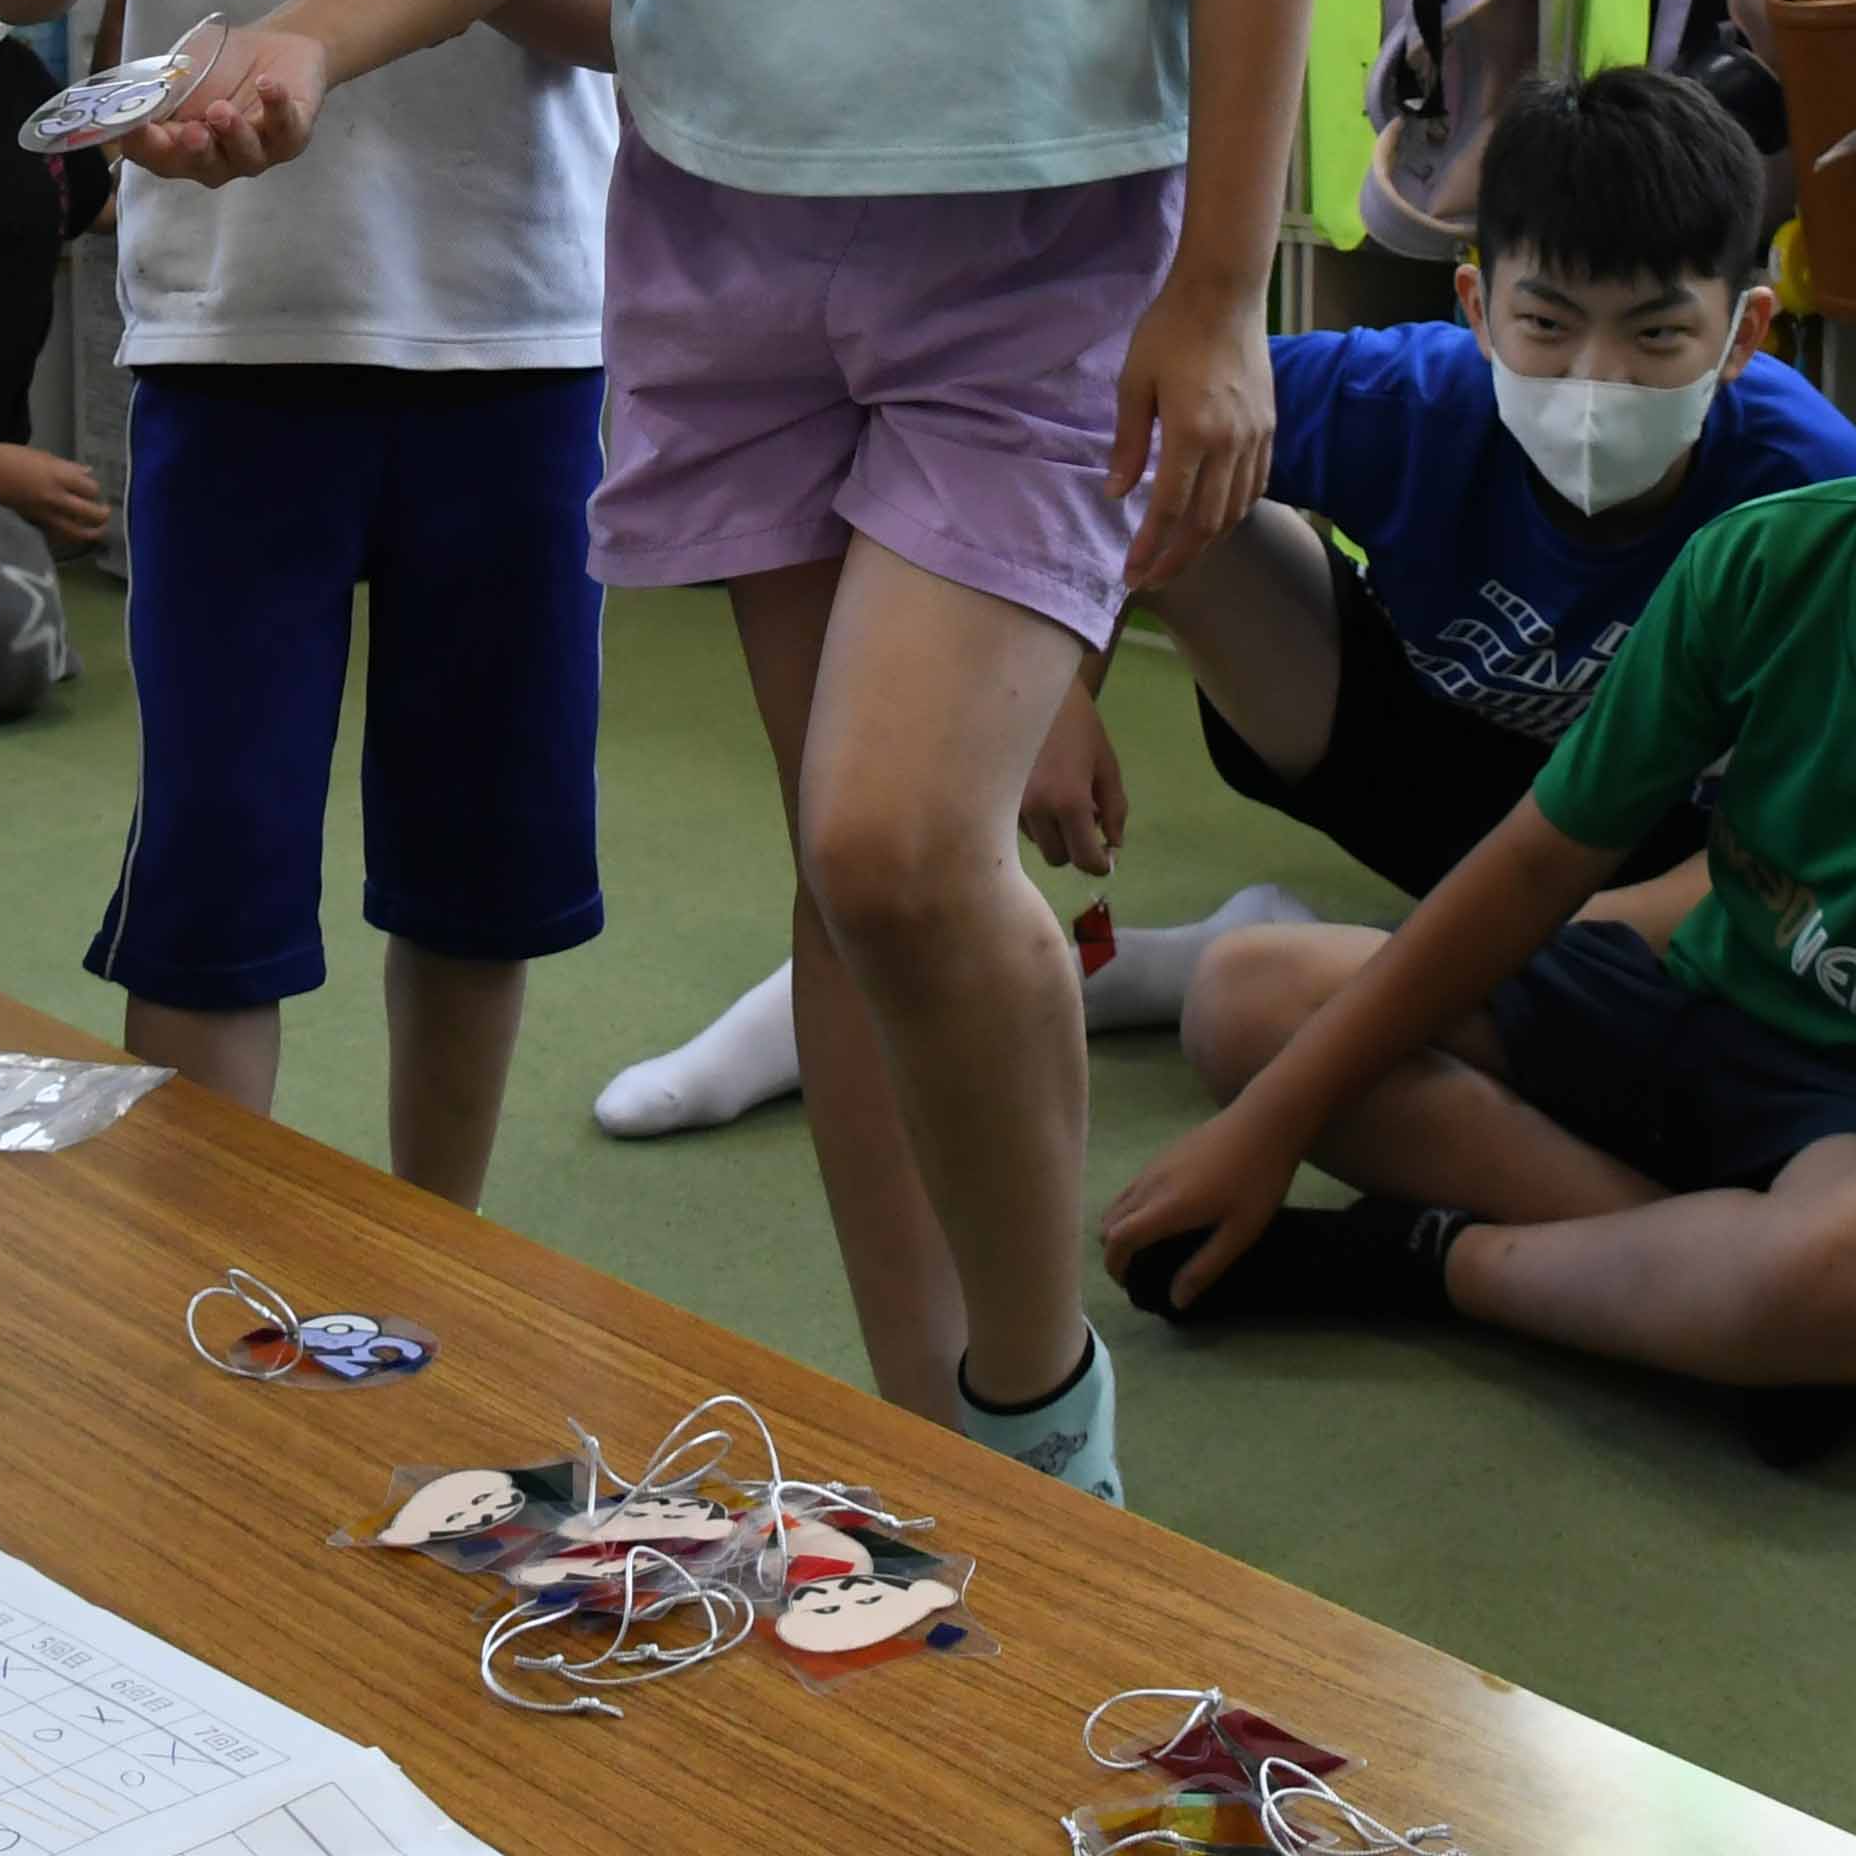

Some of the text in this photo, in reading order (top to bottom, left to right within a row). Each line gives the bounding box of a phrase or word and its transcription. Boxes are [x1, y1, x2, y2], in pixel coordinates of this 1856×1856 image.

[31, 1635, 93, 1670] 5回目
[109, 1678, 175, 1714] 6回目
[192, 1726, 260, 1763] 7回目
